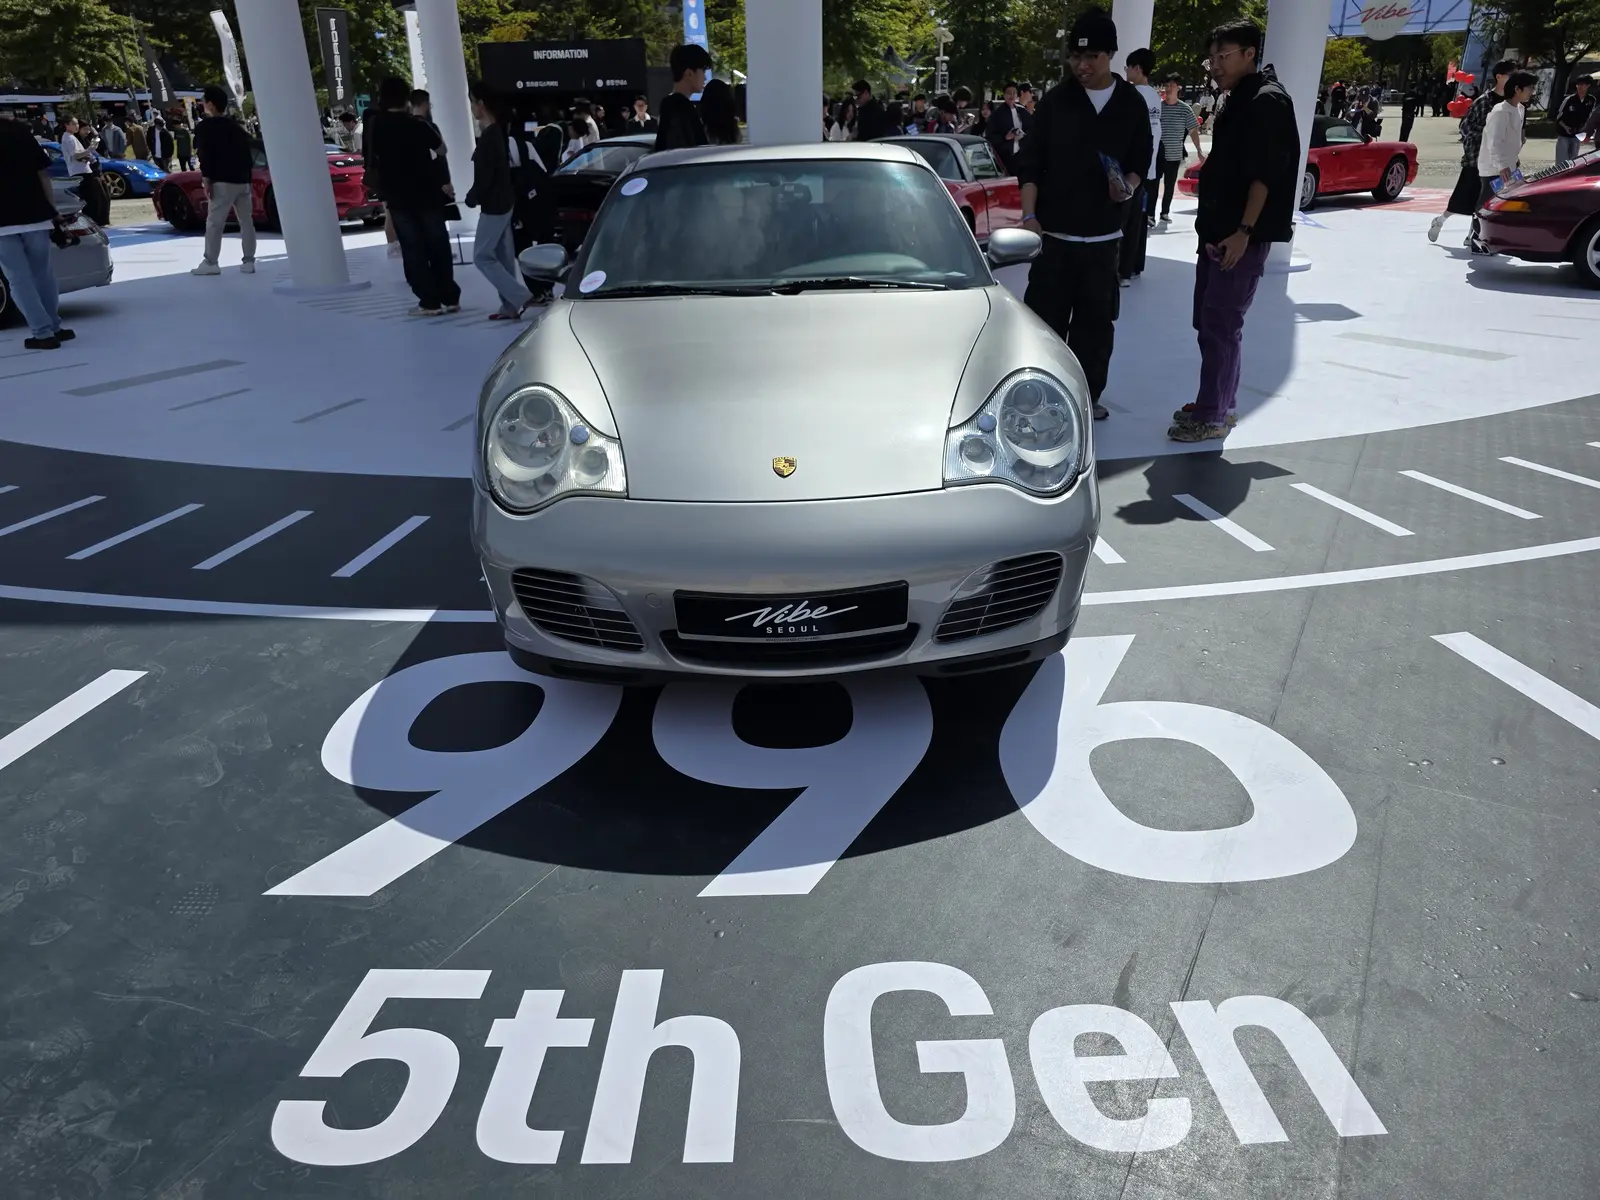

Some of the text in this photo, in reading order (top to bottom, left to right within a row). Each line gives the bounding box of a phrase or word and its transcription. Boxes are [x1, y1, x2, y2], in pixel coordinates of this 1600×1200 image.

[1346, 2, 1424, 23] Vibe
[329, 17, 345, 101] PORSCHE
[533, 49, 589, 60] INFORMATION
[724, 600, 859, 628] Vibe
[766, 625, 819, 635] SEOUL
[263, 634, 1358, 897] 996
[270, 961, 1389, 1167] 5th Gen
